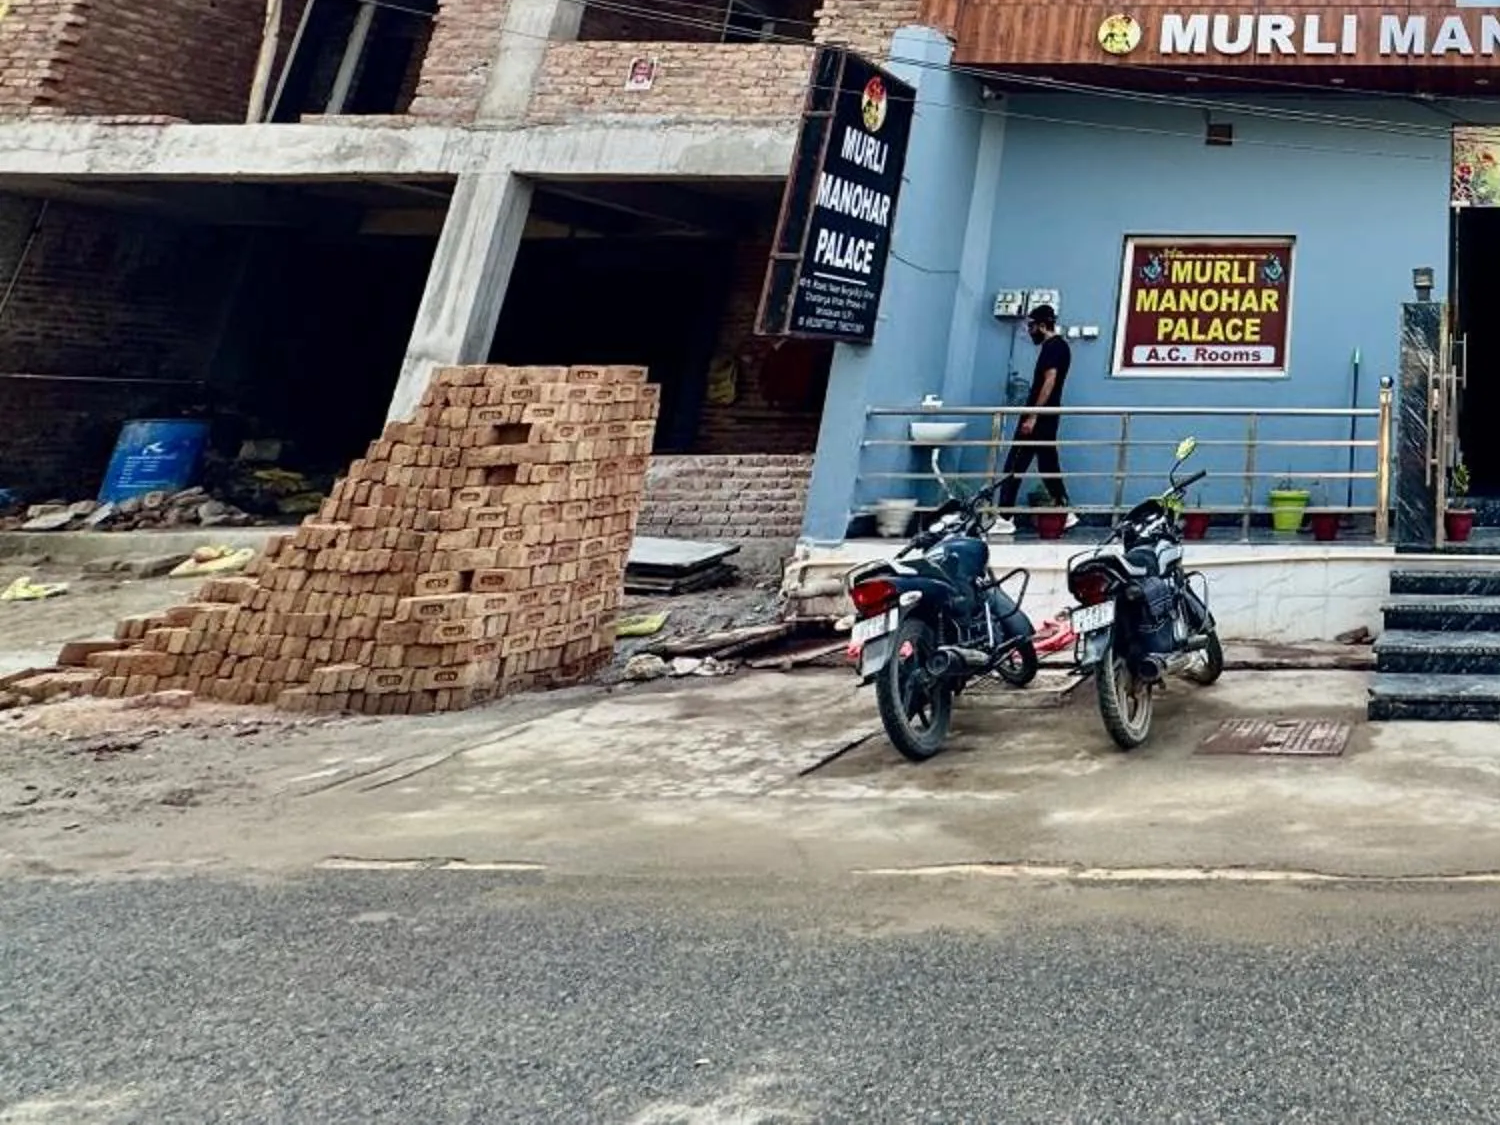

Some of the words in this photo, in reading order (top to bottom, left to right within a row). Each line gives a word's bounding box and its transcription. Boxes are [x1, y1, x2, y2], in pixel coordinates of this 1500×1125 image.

[1159, 14, 1358, 56] MURLI
[841, 126, 888, 173] MURLI
[816, 172, 890, 227] MANOHAR
[814, 228, 874, 273] PALACE
[1171, 260, 1256, 284] MURLI
[1135, 288, 1280, 312] MANOHAR
[1157, 317, 1261, 342] PALACE
[1146, 347, 1187, 362] A.C.
[1194, 347, 1262, 362] Rooms
